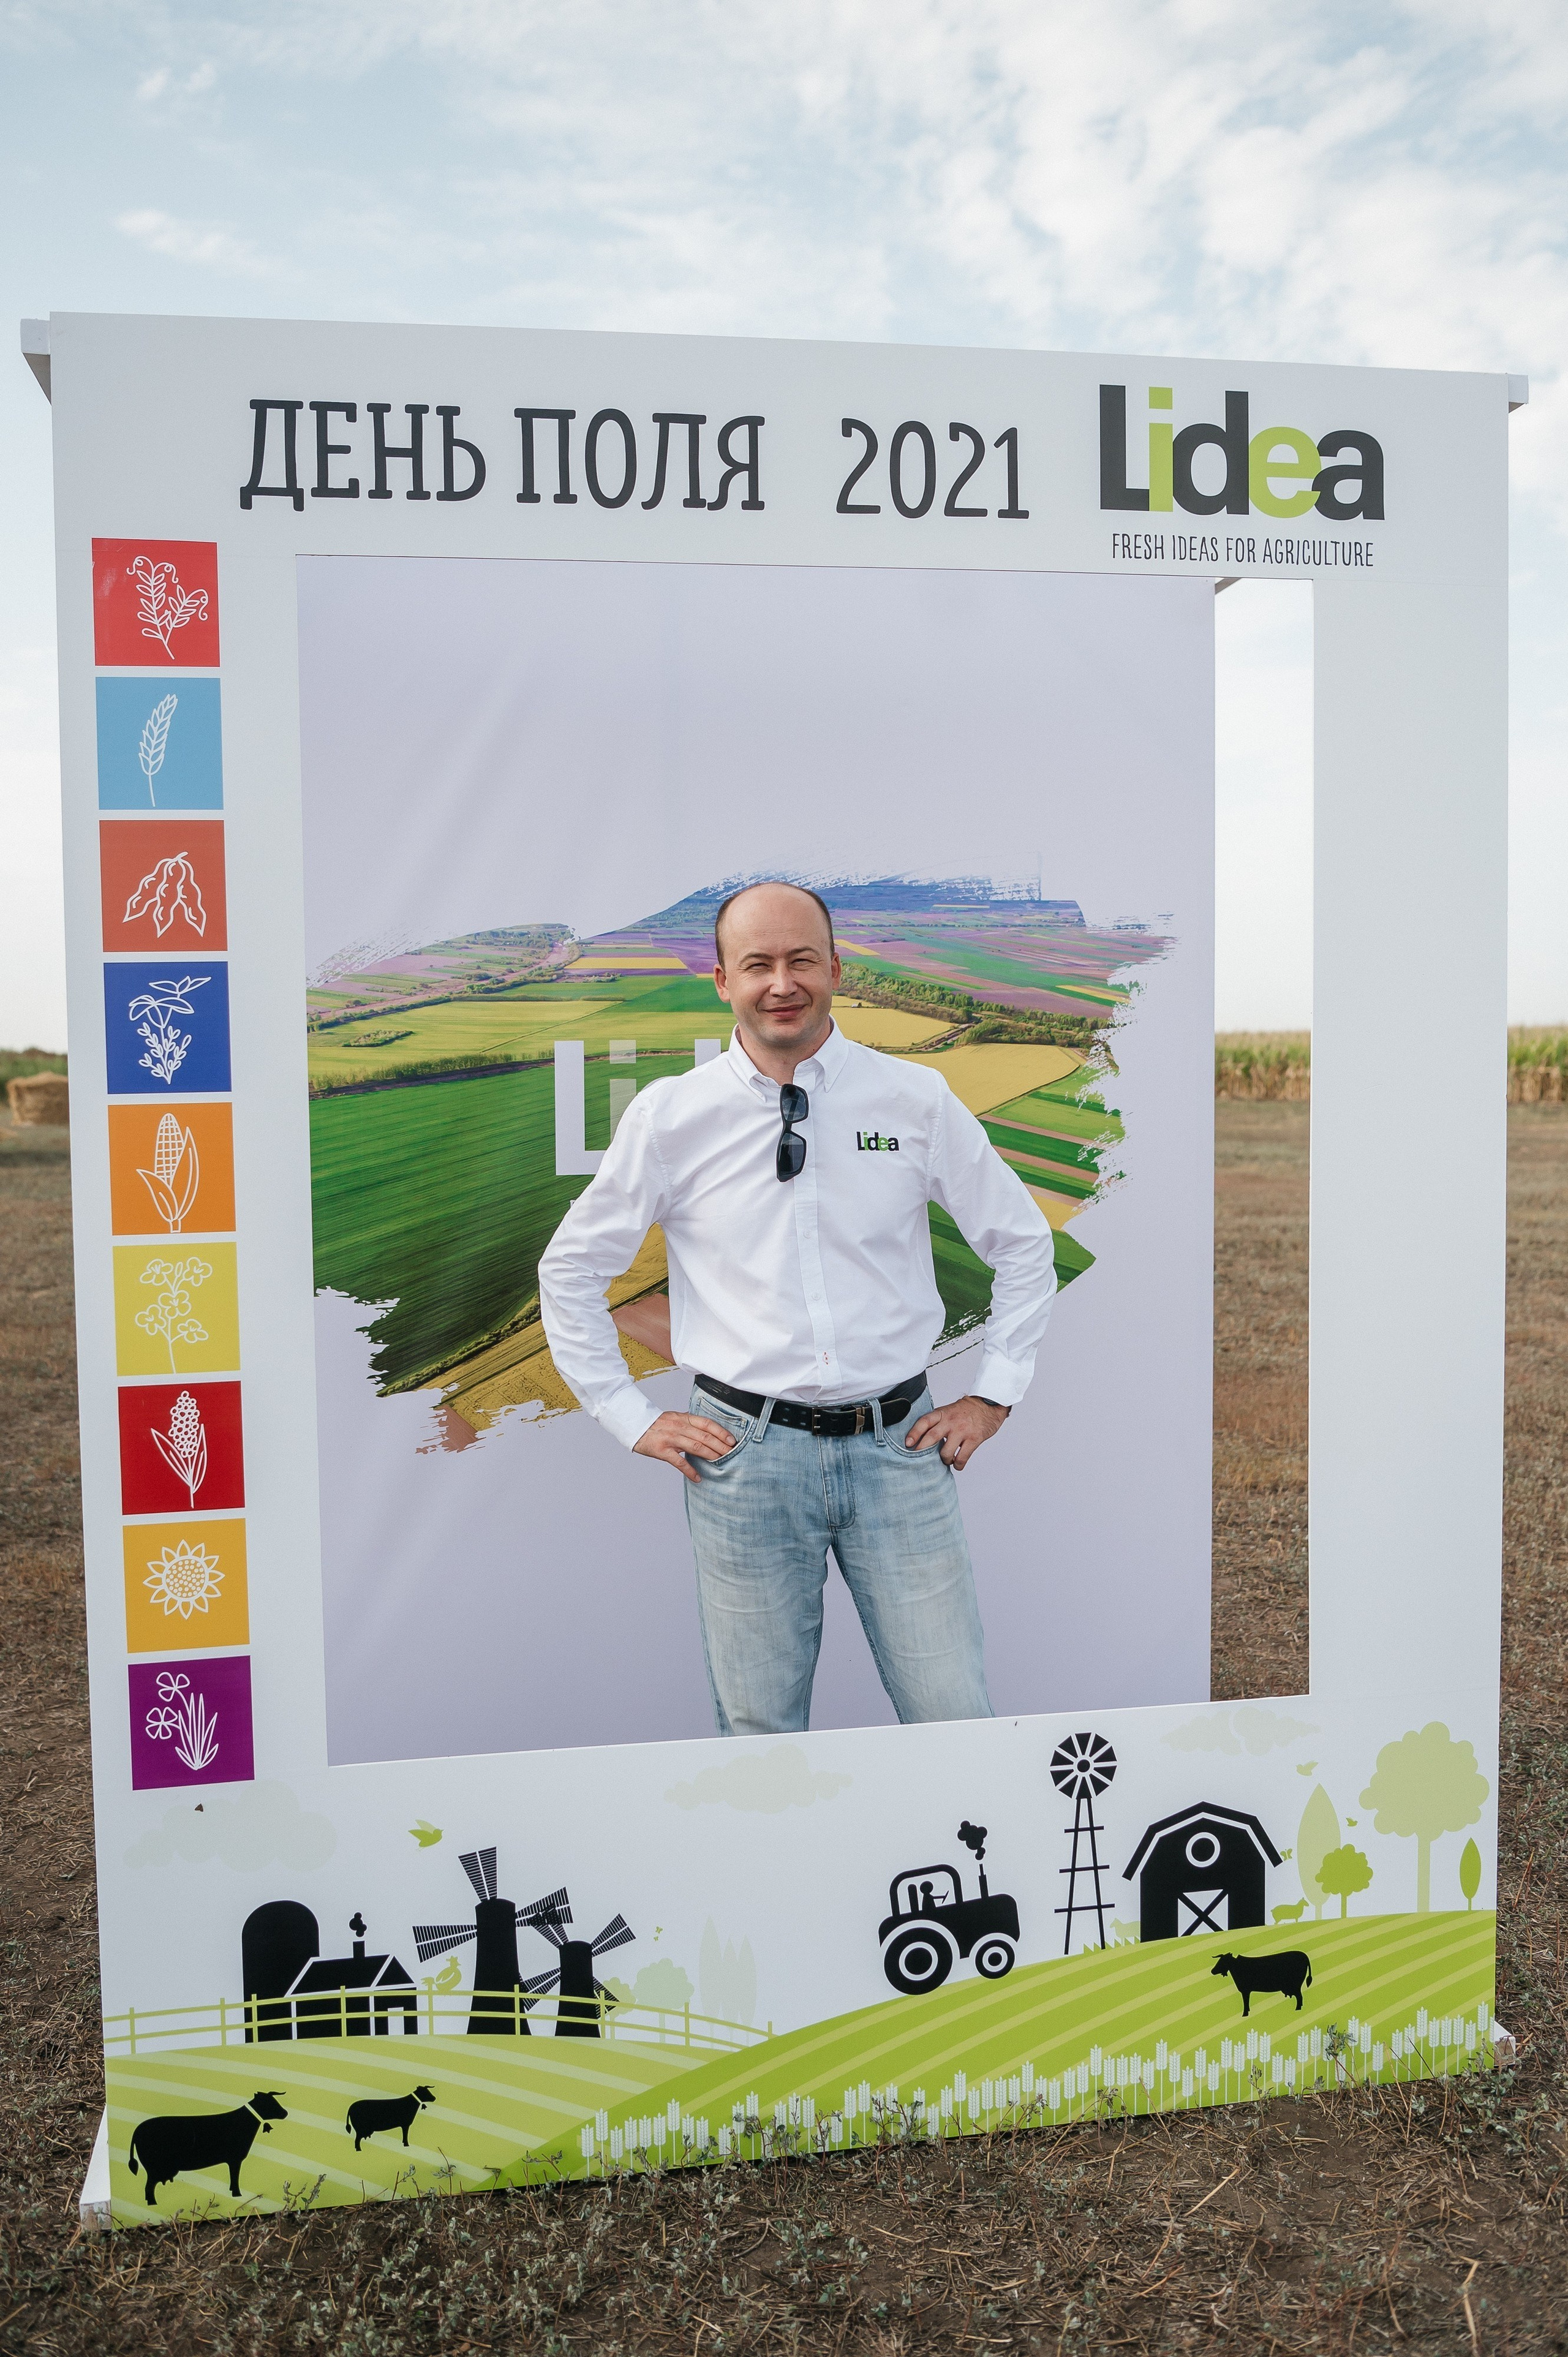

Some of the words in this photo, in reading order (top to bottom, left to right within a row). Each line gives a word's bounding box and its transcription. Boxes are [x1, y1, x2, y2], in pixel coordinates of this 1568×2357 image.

[240, 399, 486, 511] ДЕНЬ
[514, 408, 765, 511] ПОЛЯ
[836, 418, 1030, 519] 2021
[1099, 384, 1385, 521] Lidea
[1112, 533, 1164, 560] FRESH
[1172, 535, 1219, 562] IDEAS
[1226, 537, 1256, 562] FOR
[1262, 538, 1374, 567] AGRICULTURE
[856, 1131, 900, 1152] Lidea
